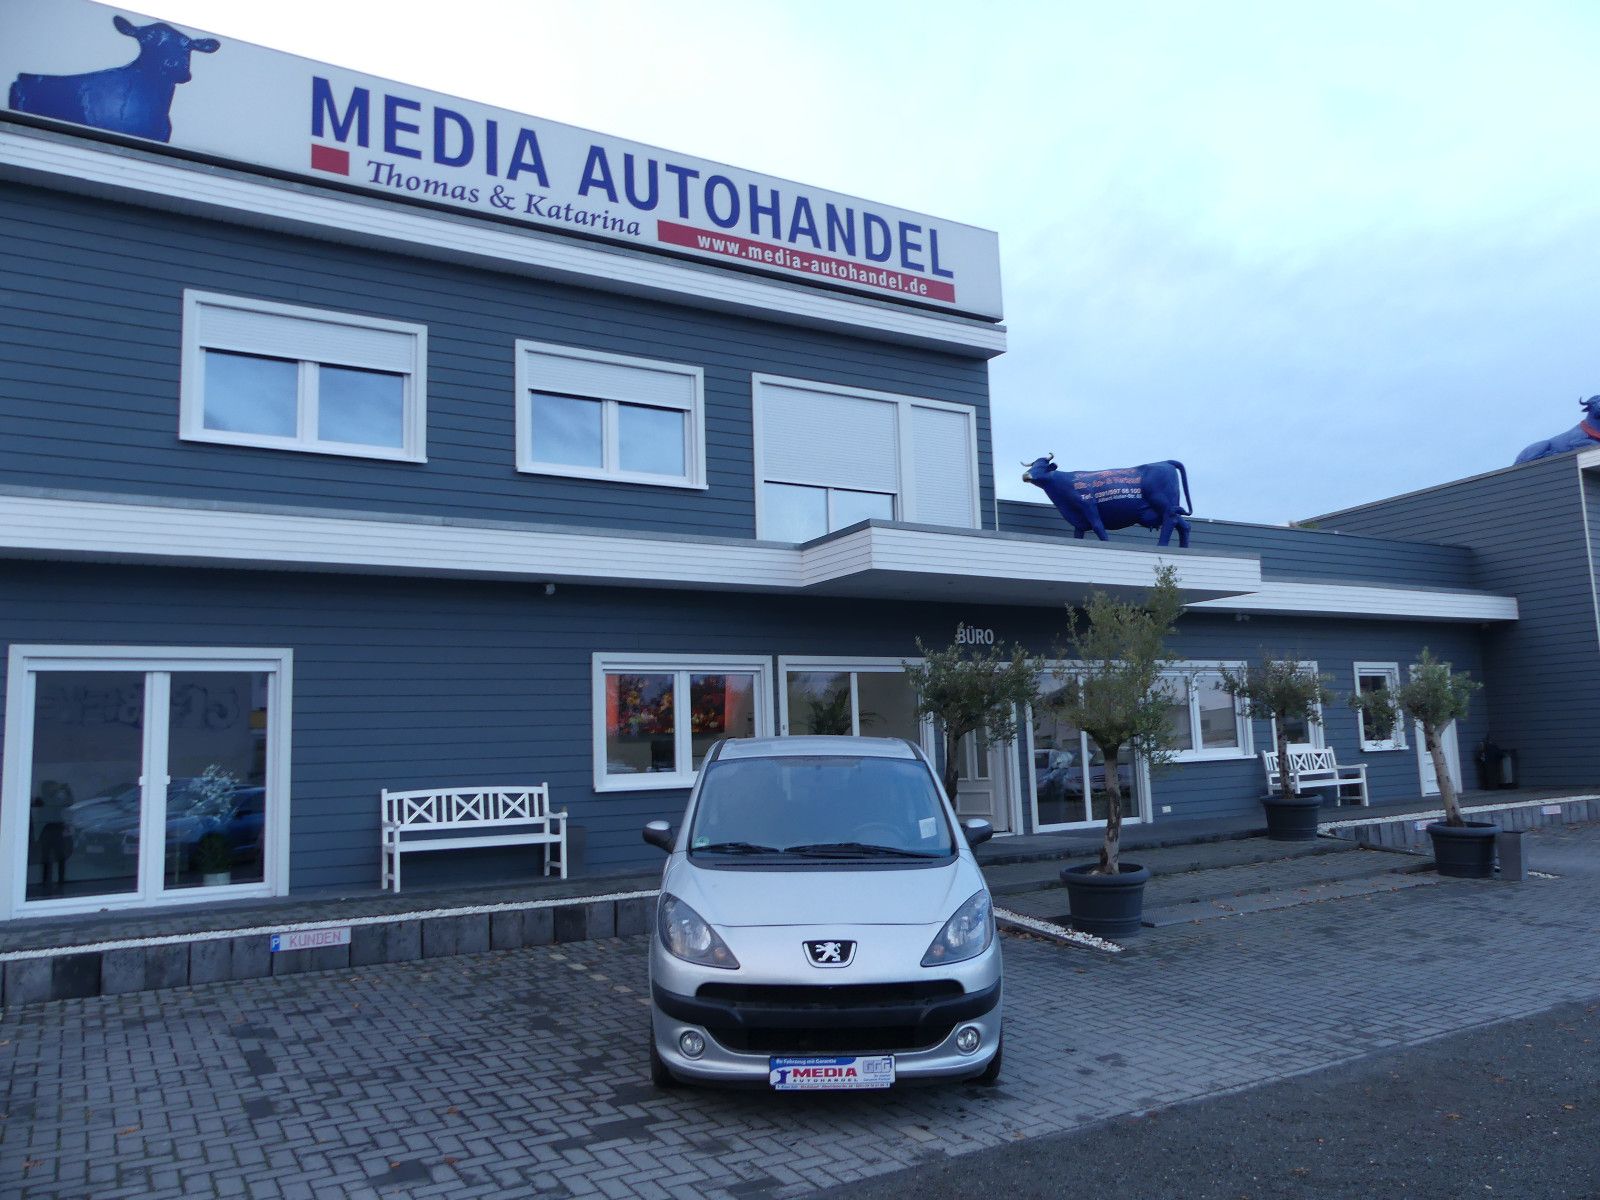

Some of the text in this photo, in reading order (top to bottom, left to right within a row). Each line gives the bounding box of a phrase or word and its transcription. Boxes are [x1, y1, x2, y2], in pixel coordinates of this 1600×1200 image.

[311, 75, 954, 280] MEDIA AUTOHANDEL
[367, 159, 641, 236] Thomas & Katarina
[696, 233, 929, 296] www.media-autohandel.de
[958, 625, 995, 645] BÜRO
[289, 931, 340, 947] KUNDEN
[792, 1068, 857, 1078] MEDIA
